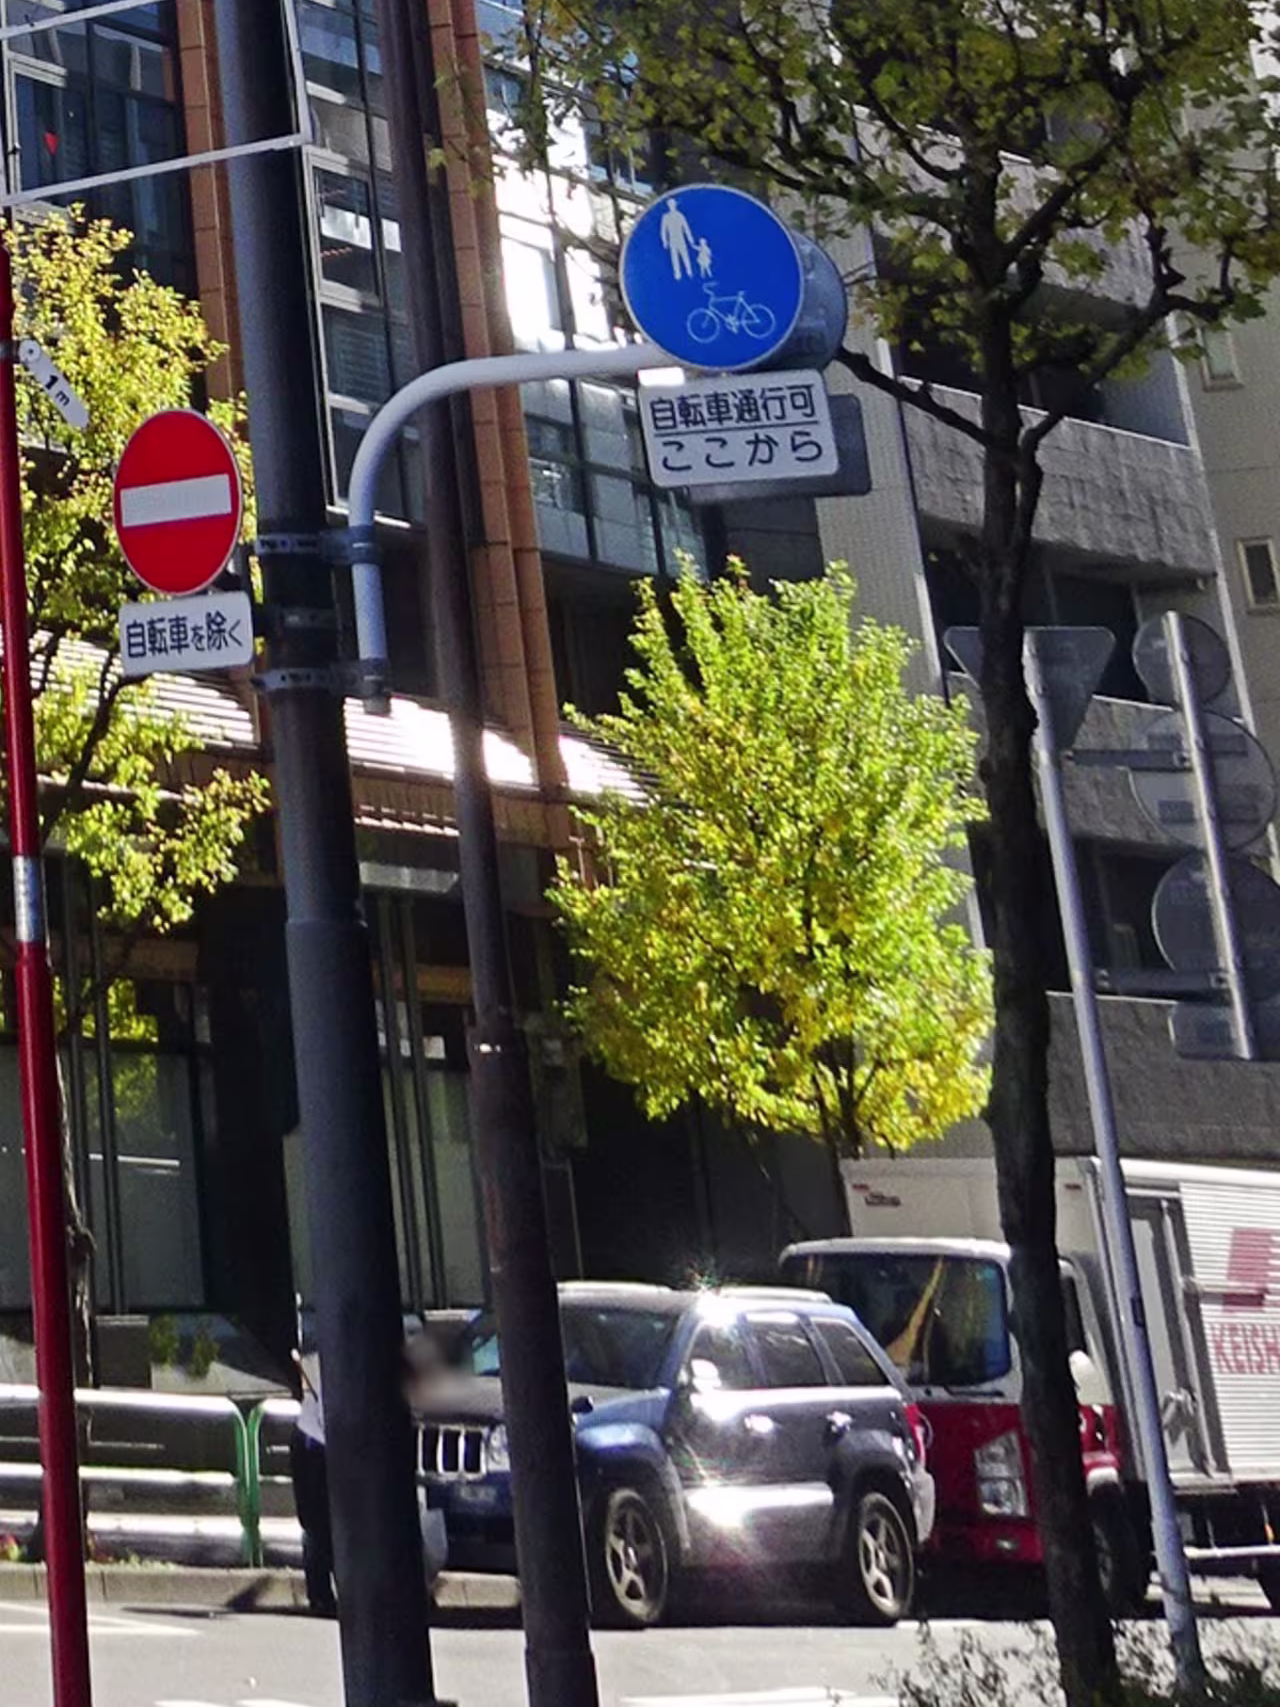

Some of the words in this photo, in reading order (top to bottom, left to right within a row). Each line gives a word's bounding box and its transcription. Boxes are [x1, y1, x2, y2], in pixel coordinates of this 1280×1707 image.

[650, 383, 818, 431] 自転車通行可
[661, 430, 824, 472] ここから
[125, 610, 244, 659] 自転車を除く
